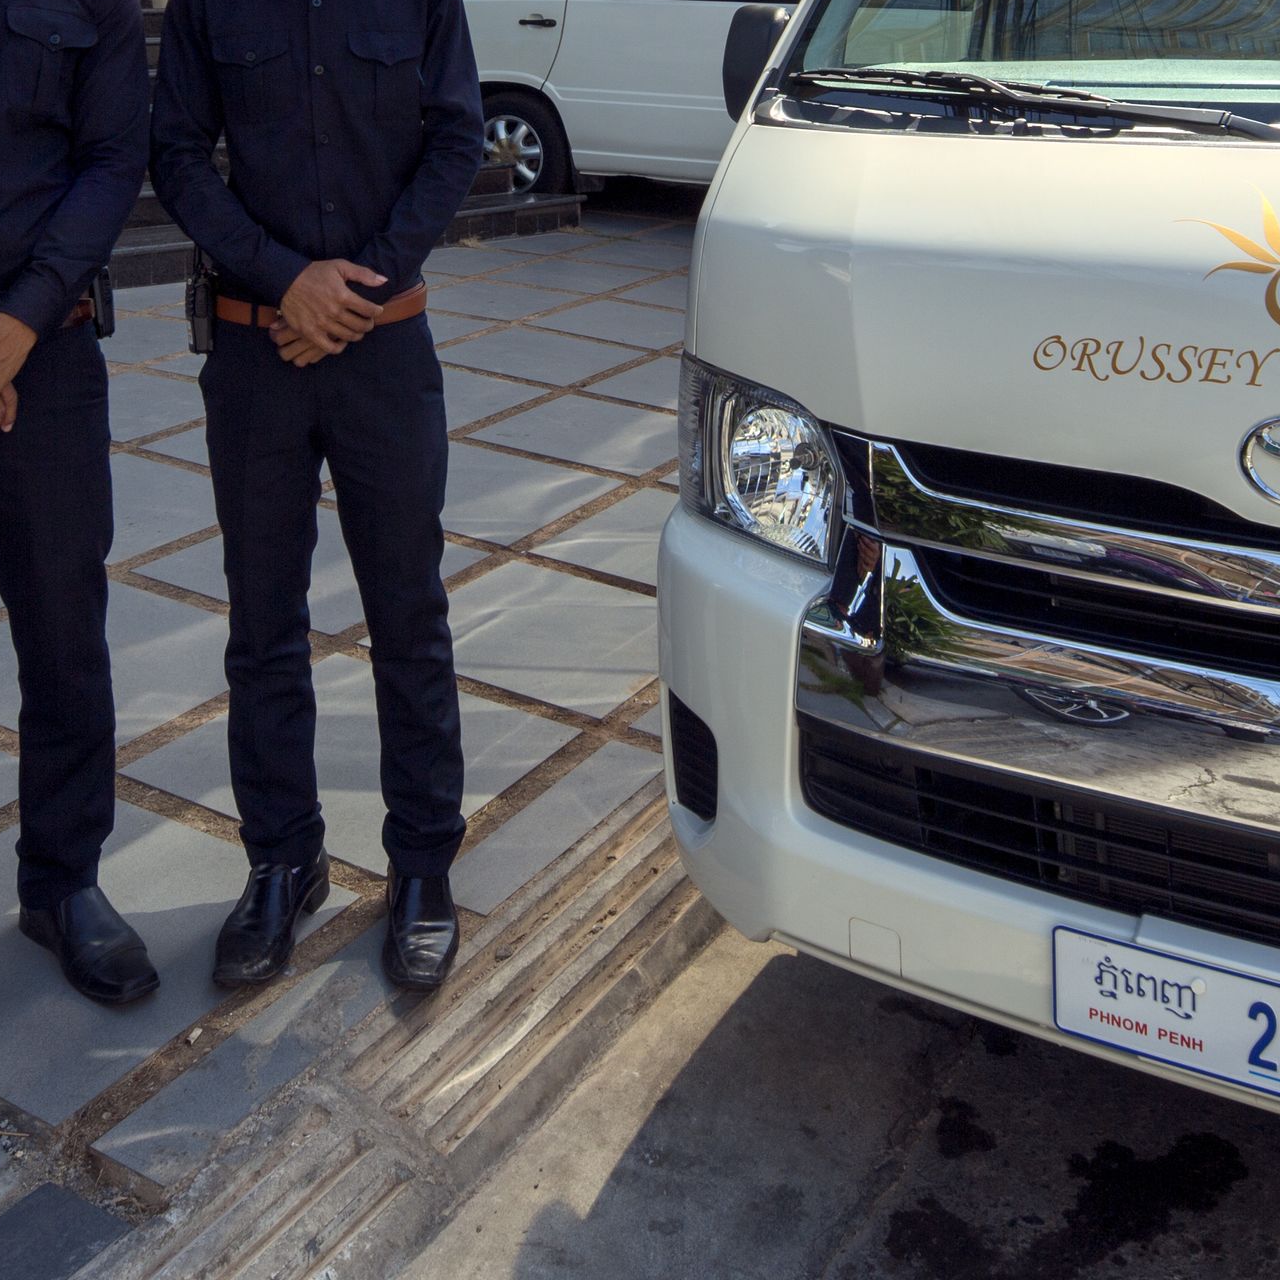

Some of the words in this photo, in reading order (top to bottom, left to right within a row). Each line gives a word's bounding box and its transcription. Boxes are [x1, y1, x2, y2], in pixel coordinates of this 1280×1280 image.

[1033, 334, 1280, 389] ORUSSEY
[1094, 956, 1199, 1020] ភ្នំពេញ
[1088, 1007, 1149, 1037] PHNOM
[1157, 1027, 1204, 1054] PENH
